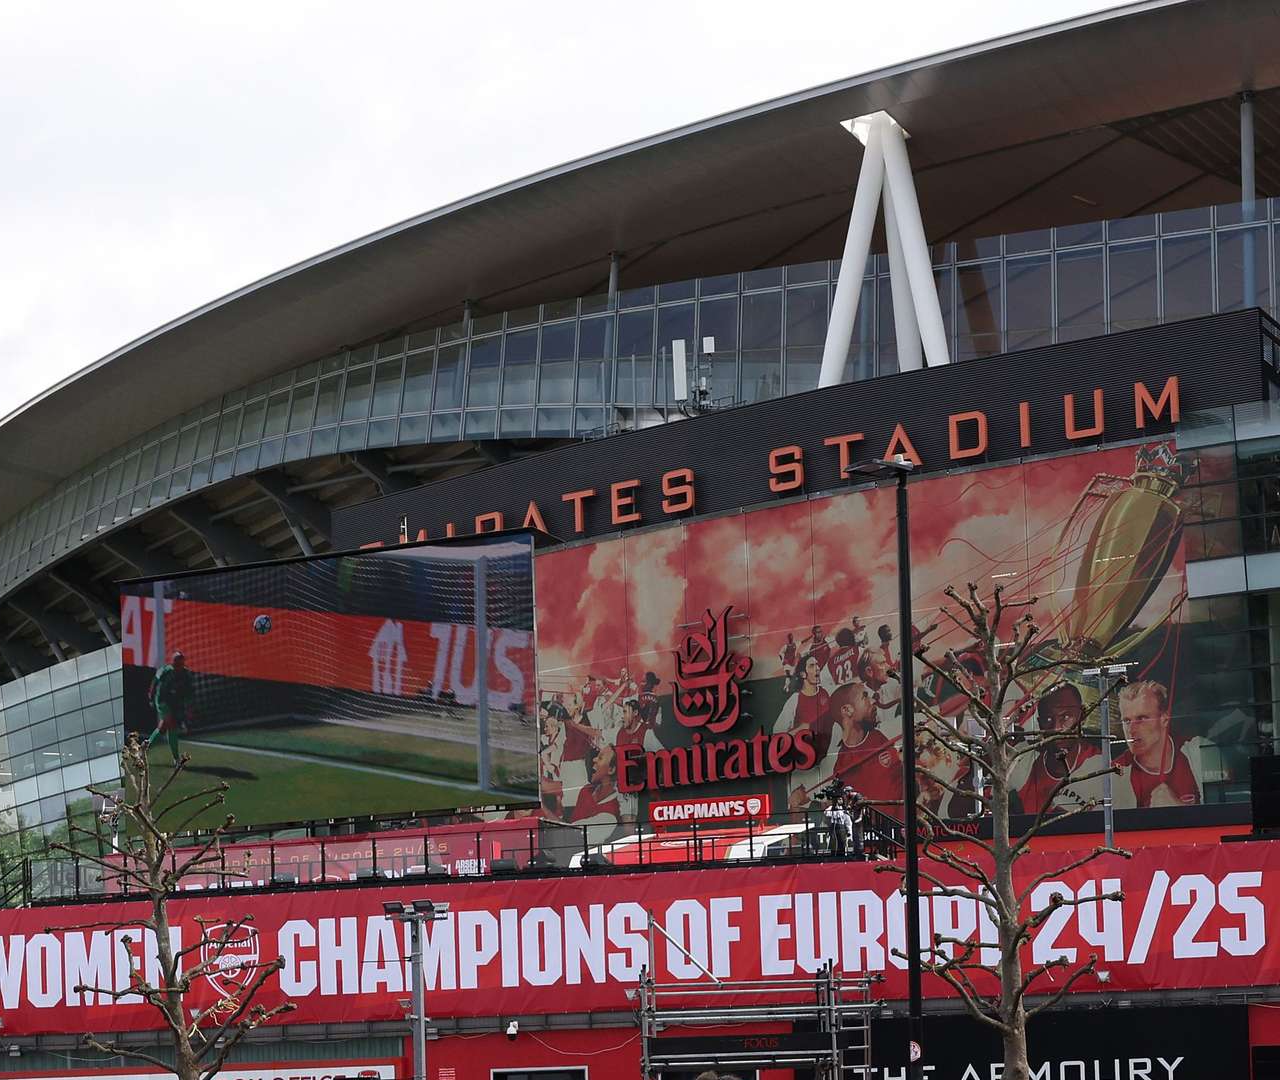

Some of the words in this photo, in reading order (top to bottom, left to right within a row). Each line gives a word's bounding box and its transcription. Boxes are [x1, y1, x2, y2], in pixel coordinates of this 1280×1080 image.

[768, 376, 1180, 492] STADIUM
[835, 661, 853, 684] 23
[617, 727, 817, 793] Emirates
[653, 800, 746, 821] CHAPMAN'S
[277, 902, 649, 997] CHAMPIONS
[666, 896, 743, 981] OF
[1031, 870, 1266, 966] 24/25
